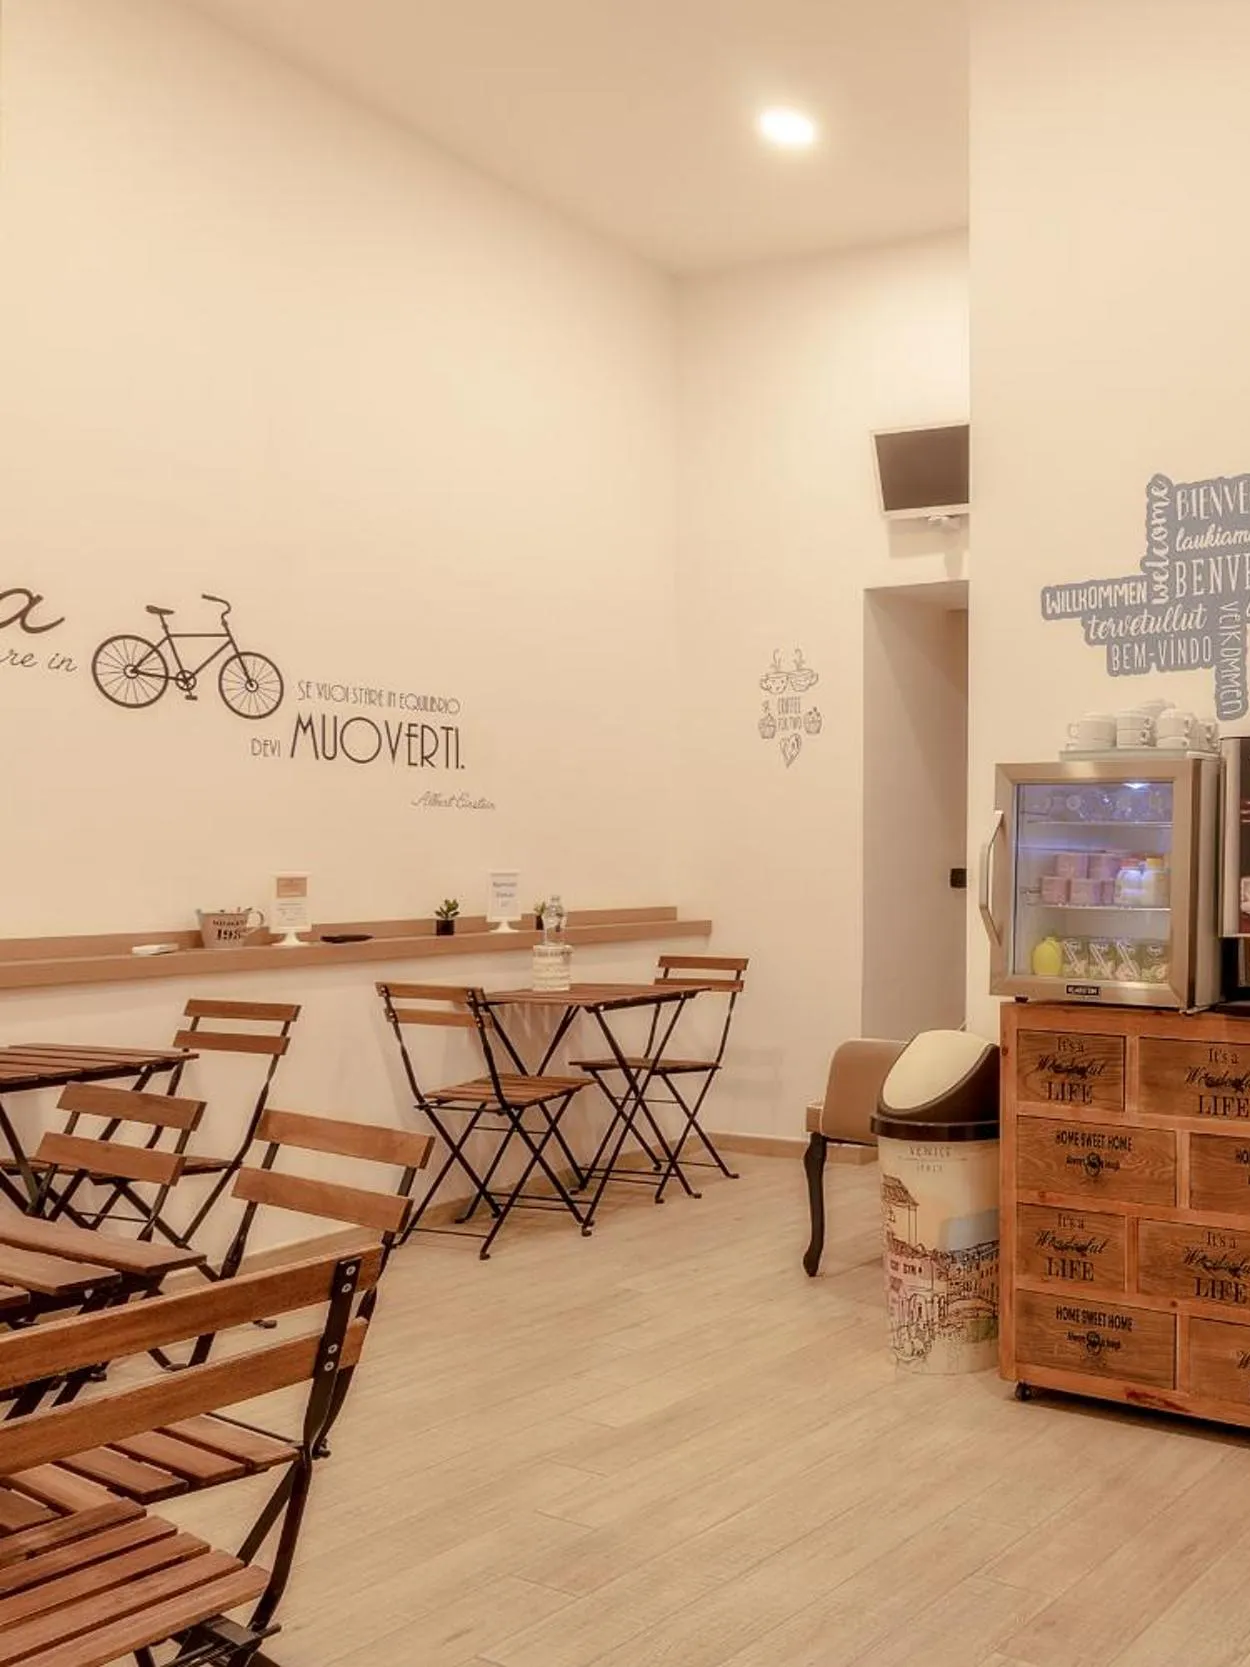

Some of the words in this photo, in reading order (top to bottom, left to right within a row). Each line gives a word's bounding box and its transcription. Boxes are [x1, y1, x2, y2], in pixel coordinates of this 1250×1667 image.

[1146, 480, 1171, 605] welcome
[1046, 580, 1148, 614] WILLKOMMEN
[1088, 604, 1209, 640] tervetullut
[48, 653, 78, 672] in
[1111, 634, 1212, 672] BEM-VINDO
[297, 680, 313, 701] SE
[316, 683, 350, 703] VUOI
[251, 738, 281, 758] DEVI
[1047, 1081, 1093, 1105] LIFE
[1198, 1094, 1250, 1118] LIFE
[1056, 1130, 1080, 1146] HOME
[1107, 1134, 1133, 1151] HOME
[1047, 1256, 1094, 1282] LIFE
[1194, 1276, 1247, 1305] LIFE
[1056, 1306, 1080, 1323] HOME
[1108, 1313, 1133, 1332] HOME
